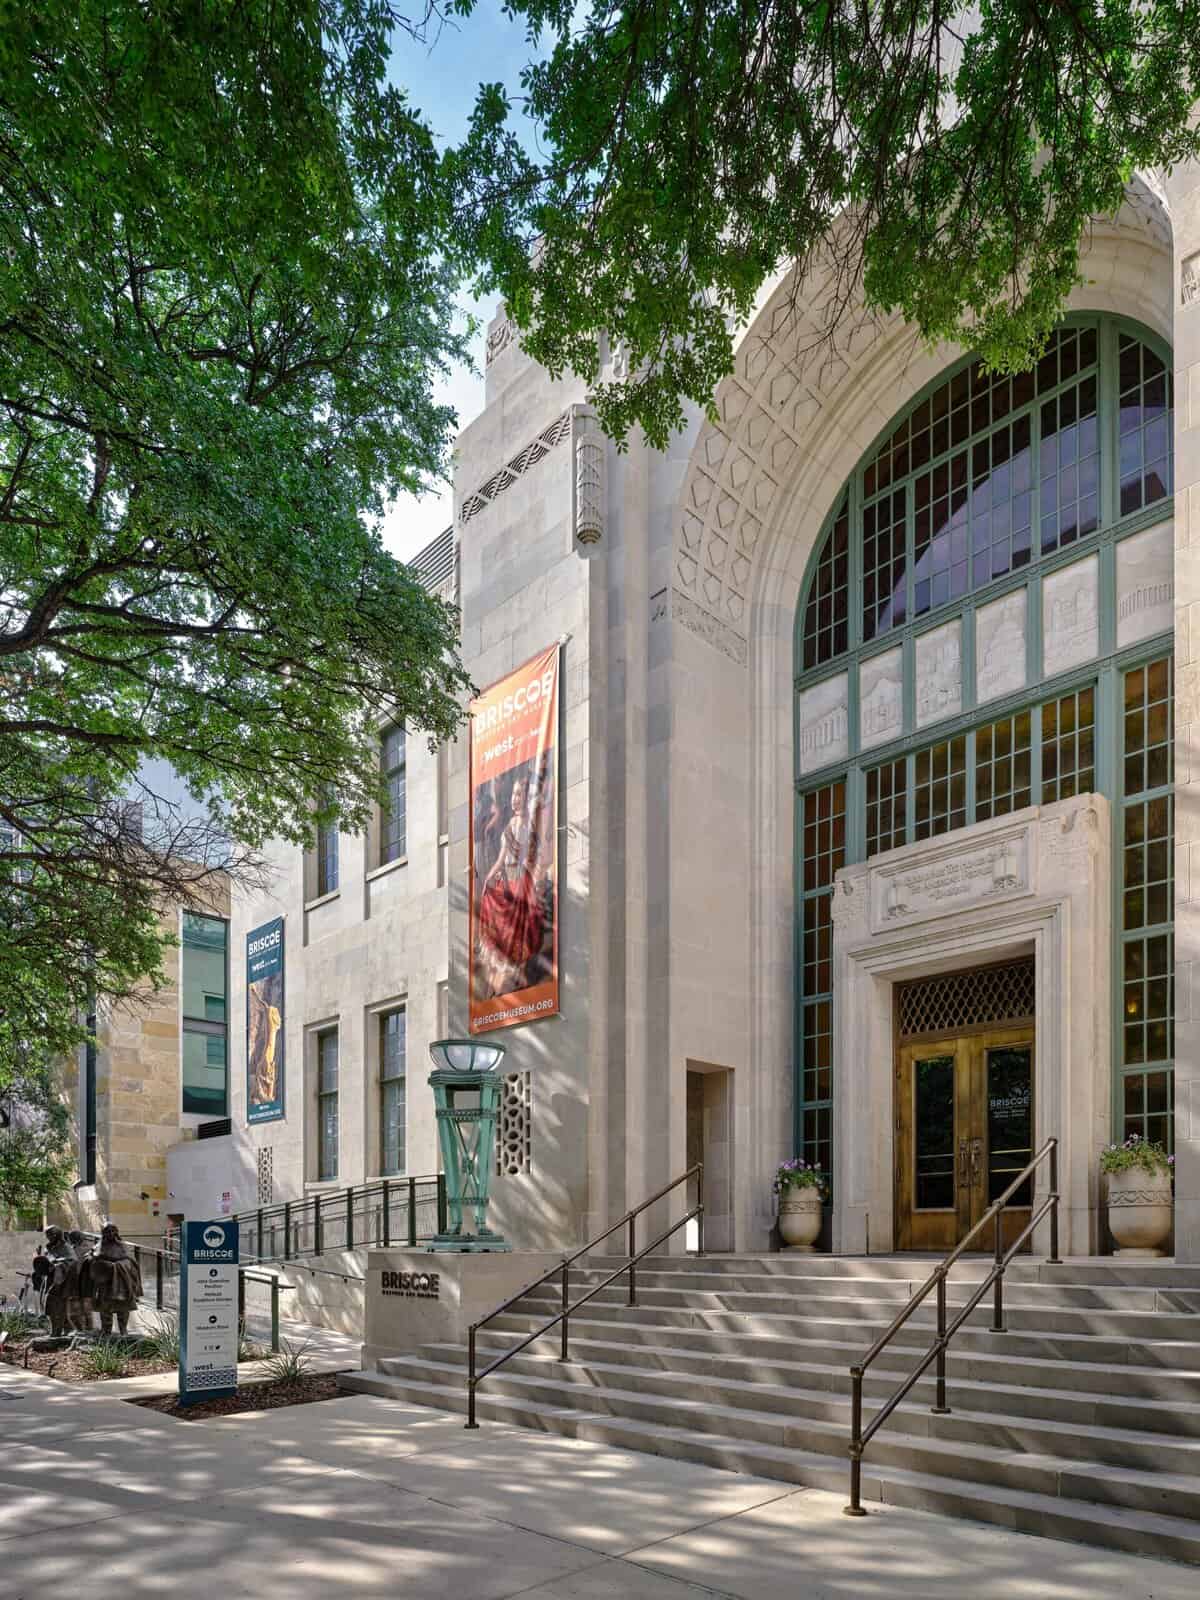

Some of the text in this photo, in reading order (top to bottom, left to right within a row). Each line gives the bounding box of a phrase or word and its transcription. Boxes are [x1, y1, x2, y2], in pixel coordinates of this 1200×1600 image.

[475, 671, 553, 737] BRISCOE
[248, 930, 281, 956] BRISCOE
[473, 1000, 554, 1025] BRISCOEMUSEUM.ORG
[990, 1096, 1030, 1107] BRISCOE
[193, 1249, 233, 1258] BRISCOE
[381, 1271, 440, 1292] BRISCOE
